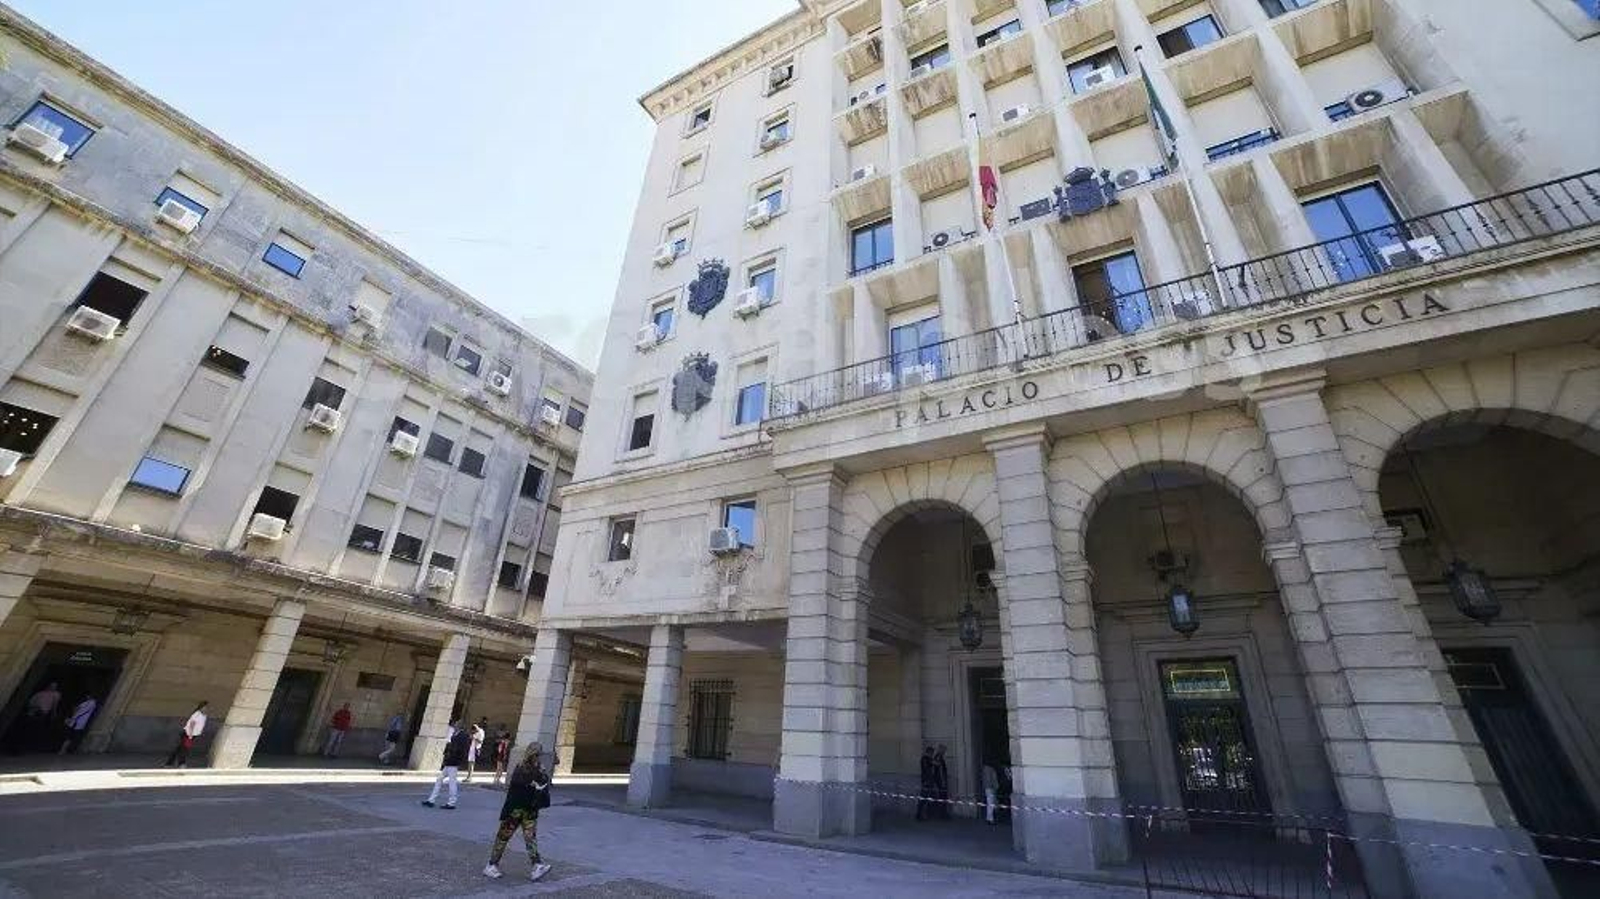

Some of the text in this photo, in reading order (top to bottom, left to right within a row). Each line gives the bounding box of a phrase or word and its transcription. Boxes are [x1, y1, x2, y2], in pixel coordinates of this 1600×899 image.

[895, 293, 1449, 428] PALACIO DE JUSTICIA
